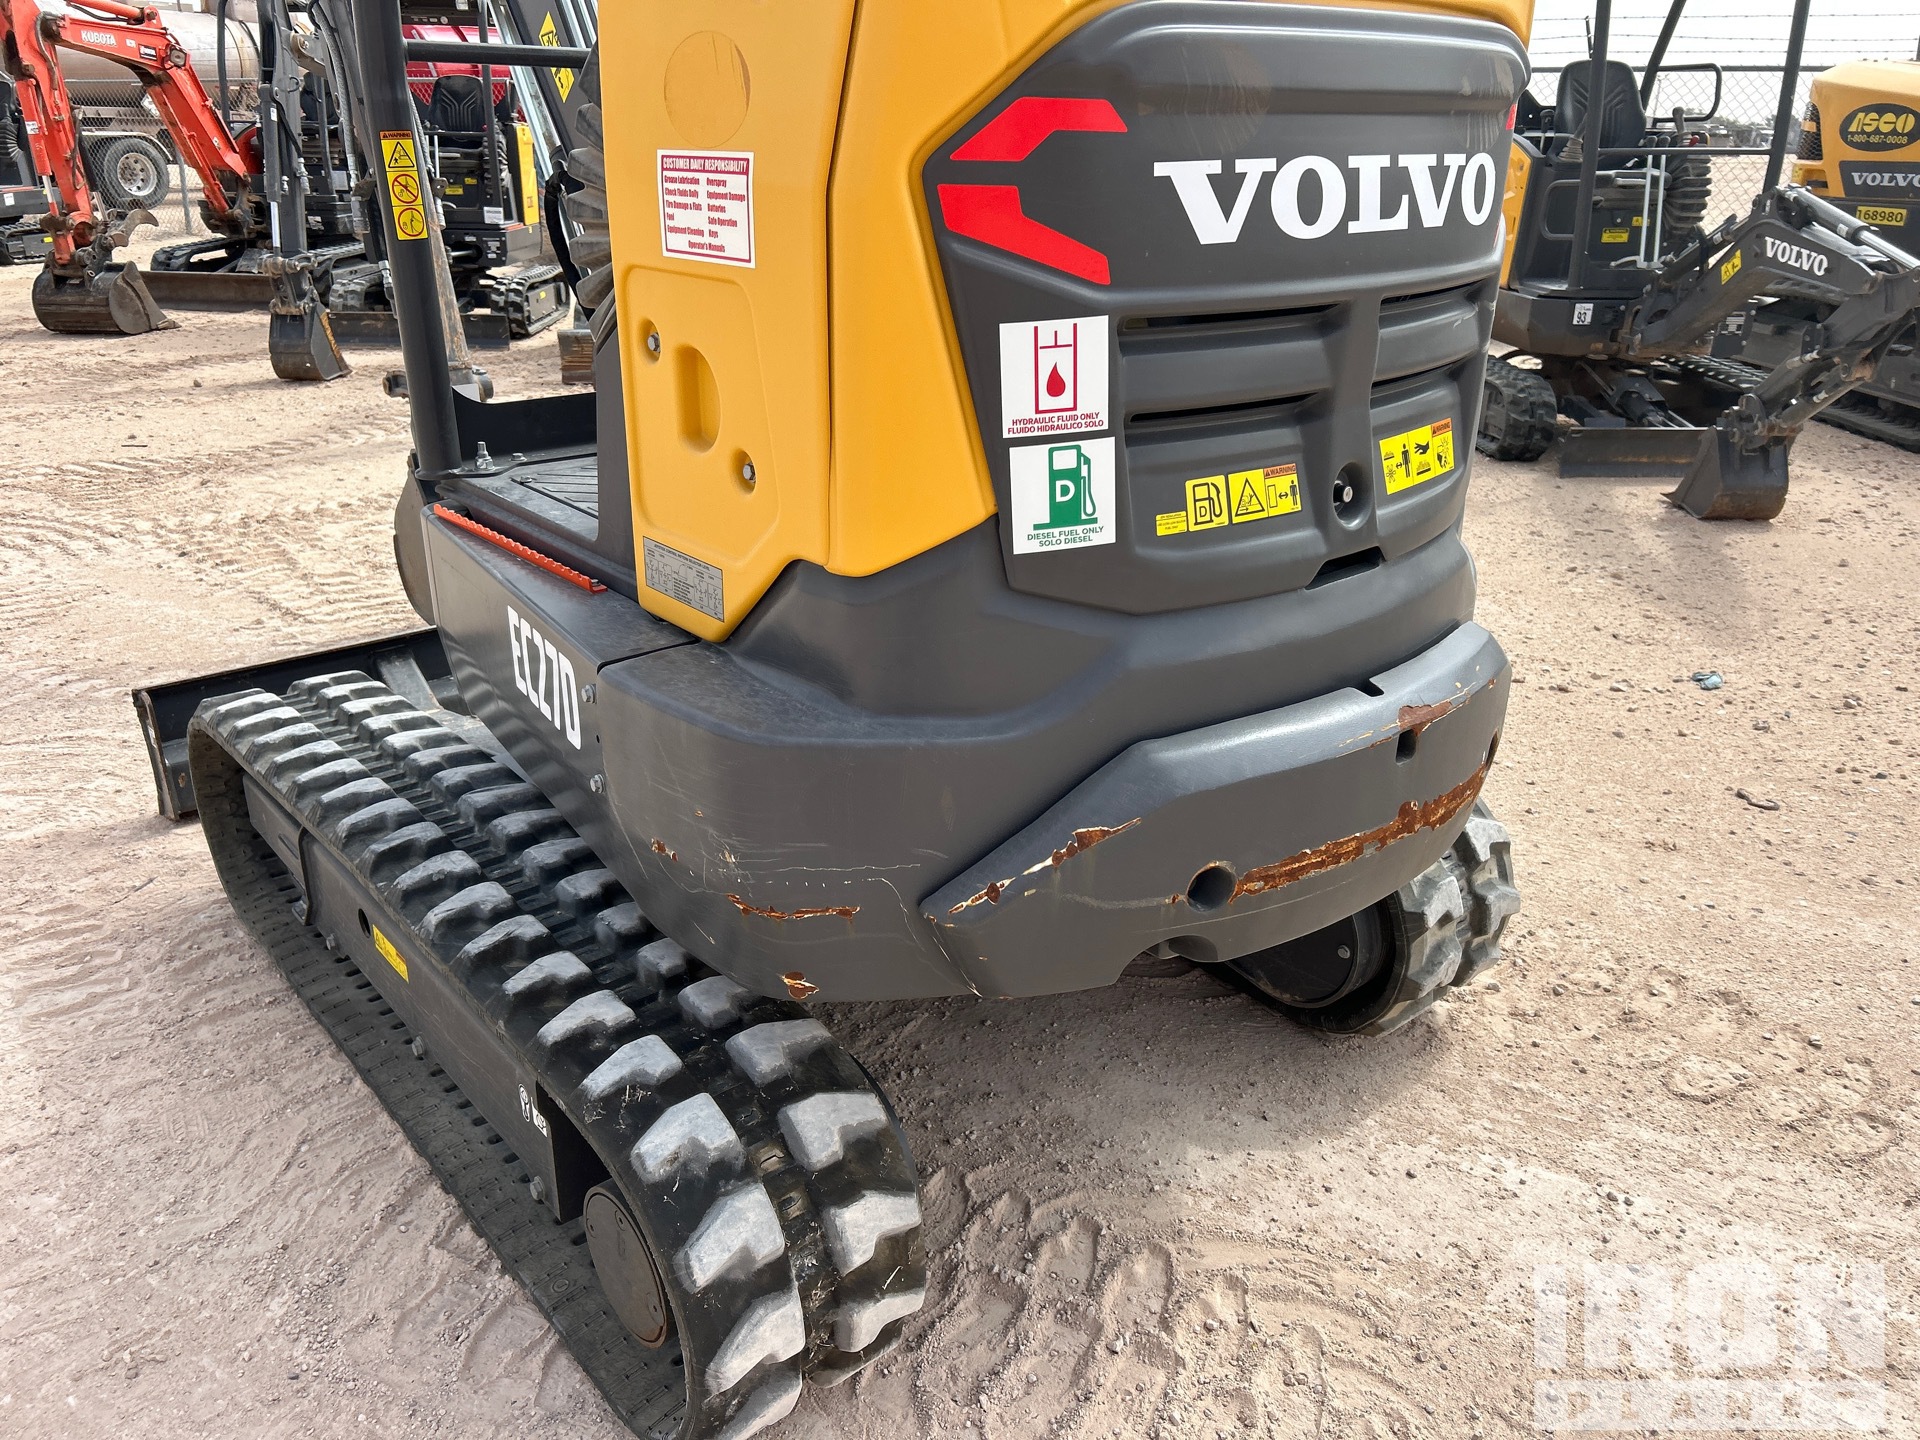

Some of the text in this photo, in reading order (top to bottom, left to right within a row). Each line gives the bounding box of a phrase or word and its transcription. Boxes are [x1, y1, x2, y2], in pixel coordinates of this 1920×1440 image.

[81, 30, 117, 46] KUBOTA
[1848, 112, 1915, 134] ASCO
[663, 157, 747, 173] CUSTOMER DAILY RESPONSIBILITY
[664, 175, 678, 184] Grease
[706, 177, 727, 188] Overspray
[664, 187, 677, 196] Check
[689, 189, 699, 199] Daily
[1153, 152, 1496, 245] VOLVO
[717, 216, 738, 228] Operation
[1857, 209, 1904, 223] 168980
[708, 229, 719, 239] Keys
[1765, 236, 1828, 276] VOLVO
[1576, 311, 1587, 324] 93
[1012, 411, 1100, 426] HYDRAULIC FLUID ONLY
[1007, 419, 1104, 435] FLUIDO HIDRAULICO SOLO
[1270, 465, 1296, 476] WARNING
[1055, 479, 1076, 502] D
[1027, 526, 1104, 541] DIESEL FUEL ONLY
[1038, 535, 1094, 547] SOLO DIESEL
[507, 605, 582, 750] EC27D
